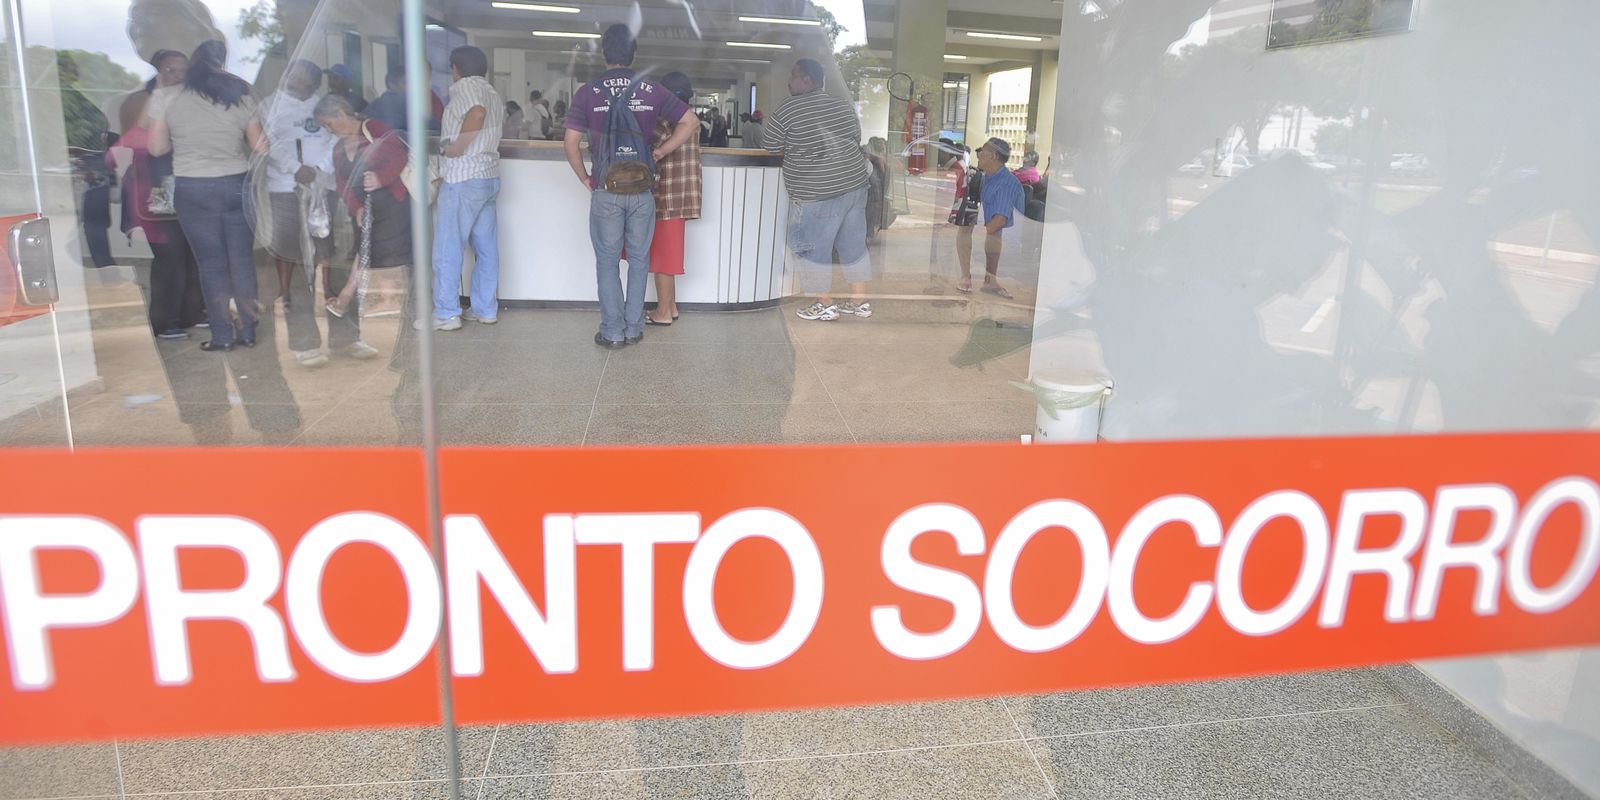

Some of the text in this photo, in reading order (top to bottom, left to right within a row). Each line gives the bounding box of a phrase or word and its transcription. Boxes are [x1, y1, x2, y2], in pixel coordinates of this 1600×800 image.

[592, 77, 653, 94] SCERDTE
[0, 475, 1600, 690] PRONTO SOCORRO
